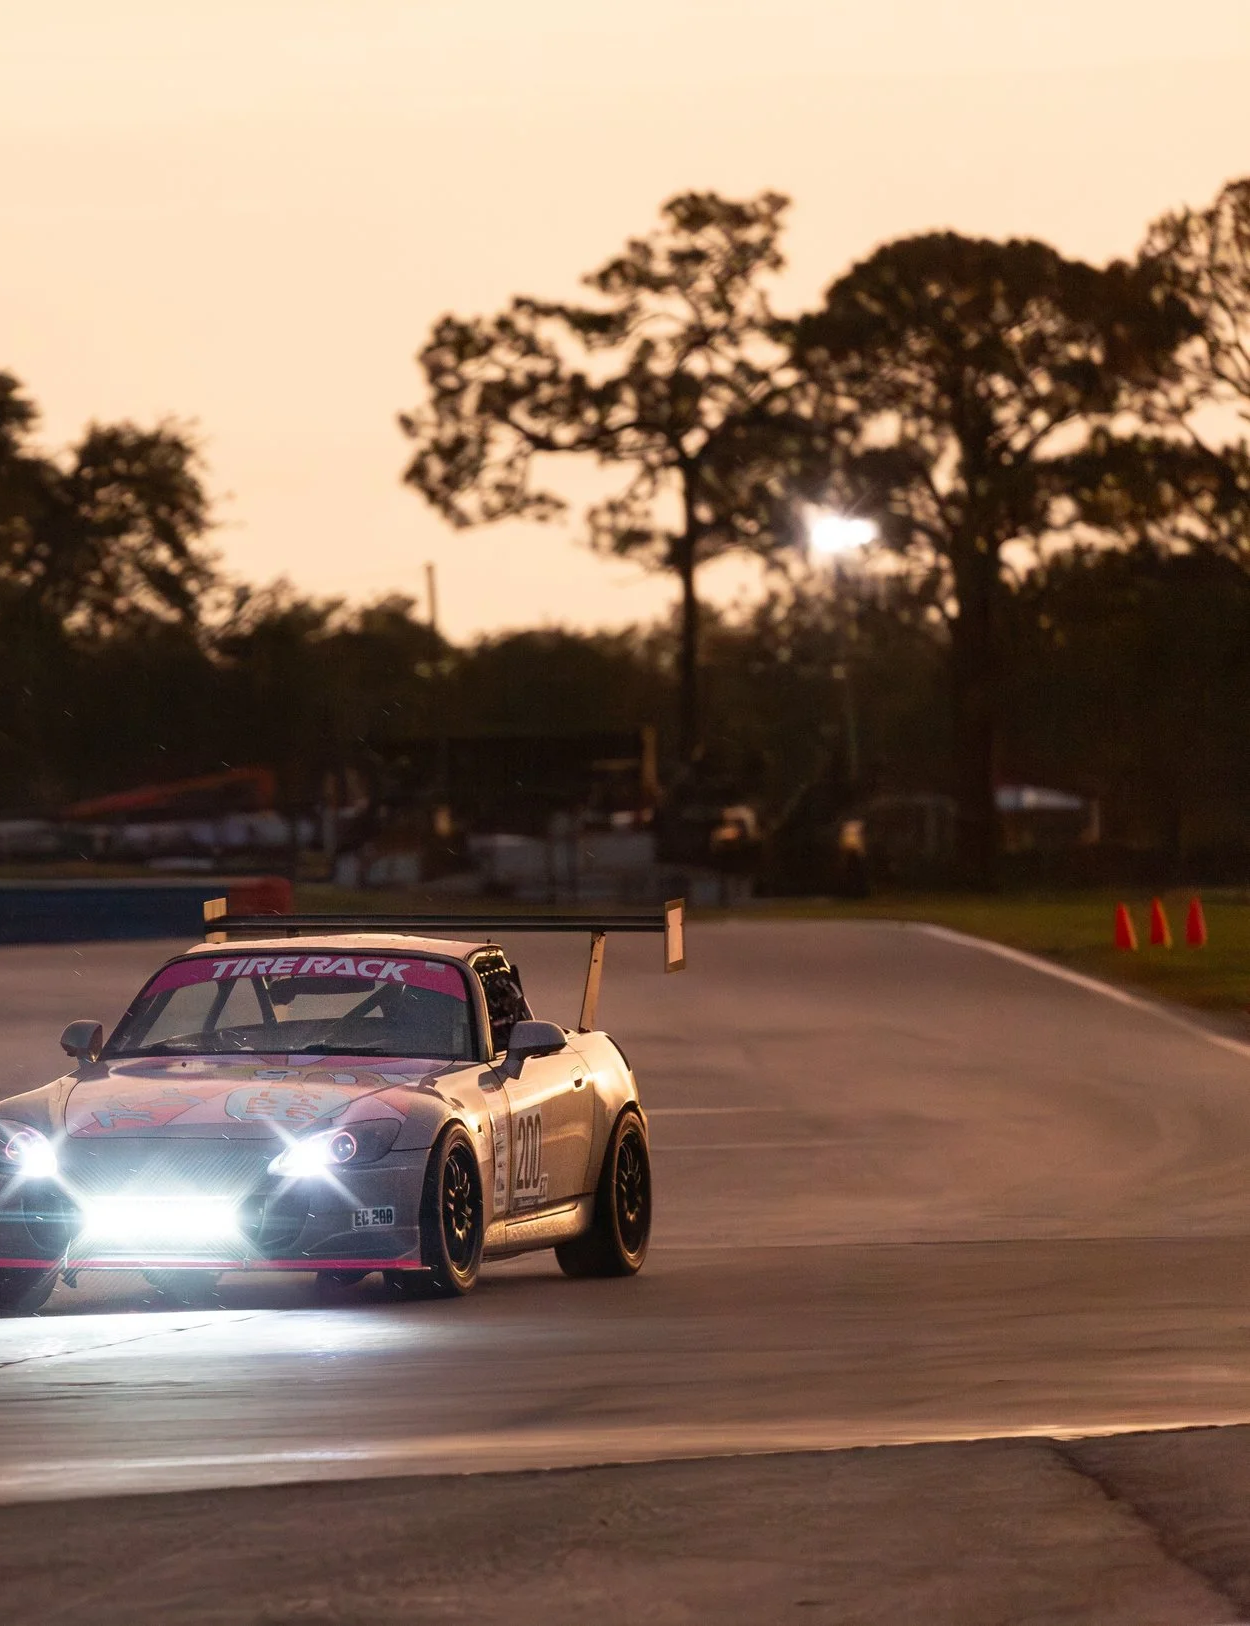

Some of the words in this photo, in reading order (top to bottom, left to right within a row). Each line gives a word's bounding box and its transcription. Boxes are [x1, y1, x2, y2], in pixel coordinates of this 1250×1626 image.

[212, 956, 299, 978] TIRE
[299, 956, 411, 981] RACK
[517, 1113, 541, 1189] 200
